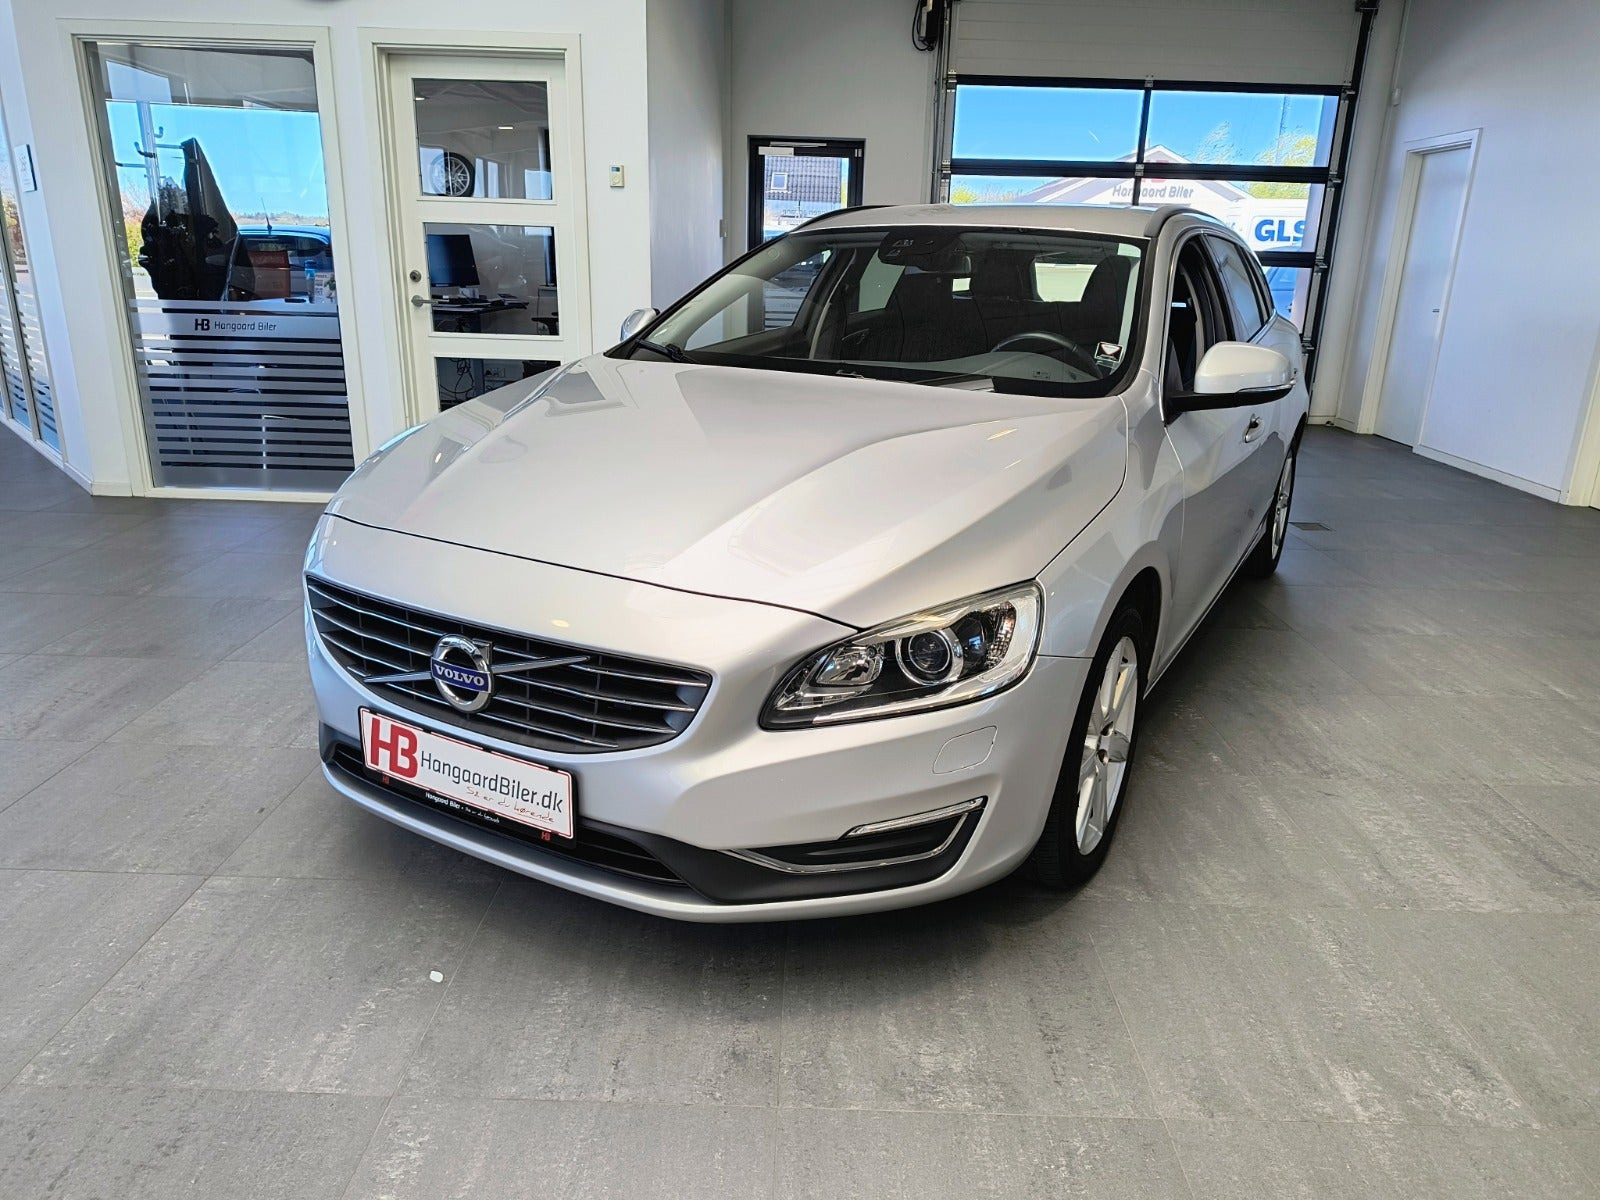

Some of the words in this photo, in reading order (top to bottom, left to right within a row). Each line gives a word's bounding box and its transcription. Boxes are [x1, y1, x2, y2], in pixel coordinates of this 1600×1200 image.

[1112, 185, 1166, 199] Hanaard
[1168, 185, 1195, 198] Biler
[1254, 219, 1306, 242] GLS
[194, 318, 211, 331] HB
[214, 321, 256, 332] Hangaard
[258, 322, 277, 331] Biler
[433, 663, 485, 687] VOLVO
[370, 717, 419, 779] HB
[421, 751, 564, 813] HangaardBiler.dk
